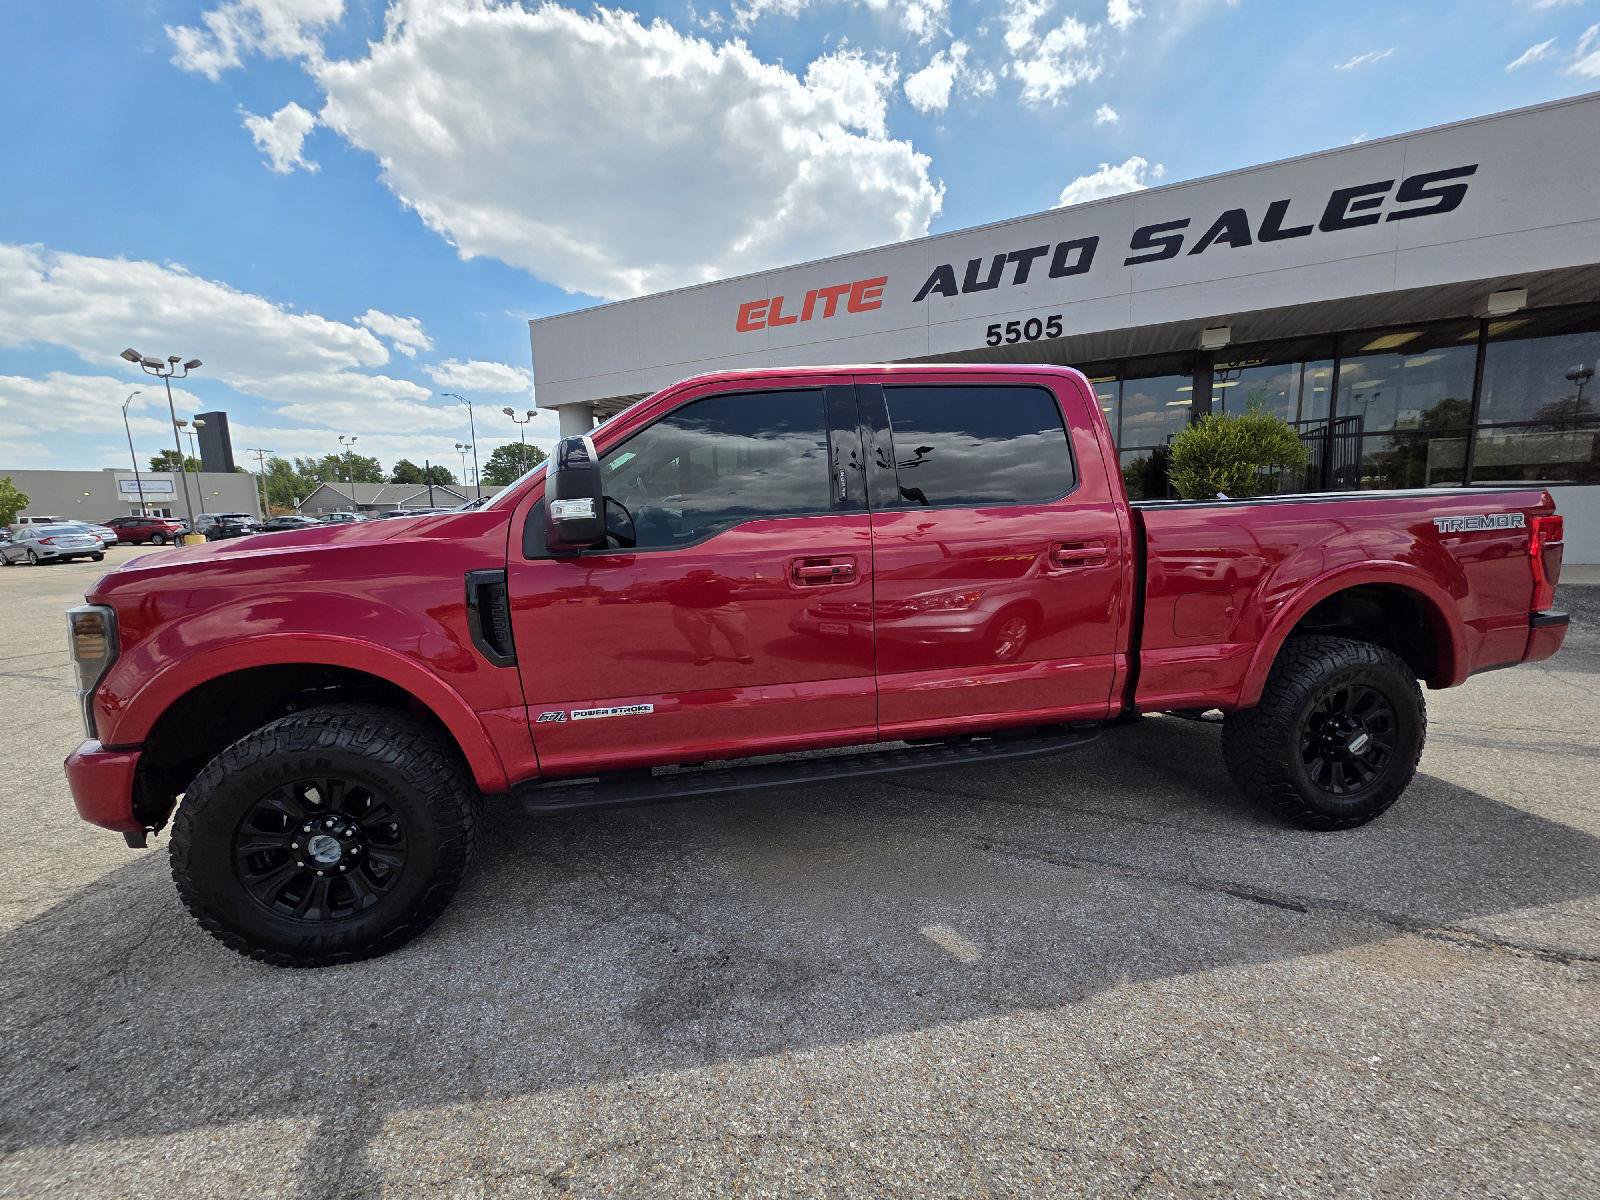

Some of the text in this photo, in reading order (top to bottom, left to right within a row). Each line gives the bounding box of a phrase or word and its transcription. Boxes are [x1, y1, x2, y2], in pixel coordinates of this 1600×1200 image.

[736, 164, 1478, 332] ELITE AUTO SALES
[986, 315, 1063, 346] 5505
[1434, 513, 1526, 533] TREMOR
[573, 709, 609, 718] POWER
[611, 705, 652, 714] STROKE
